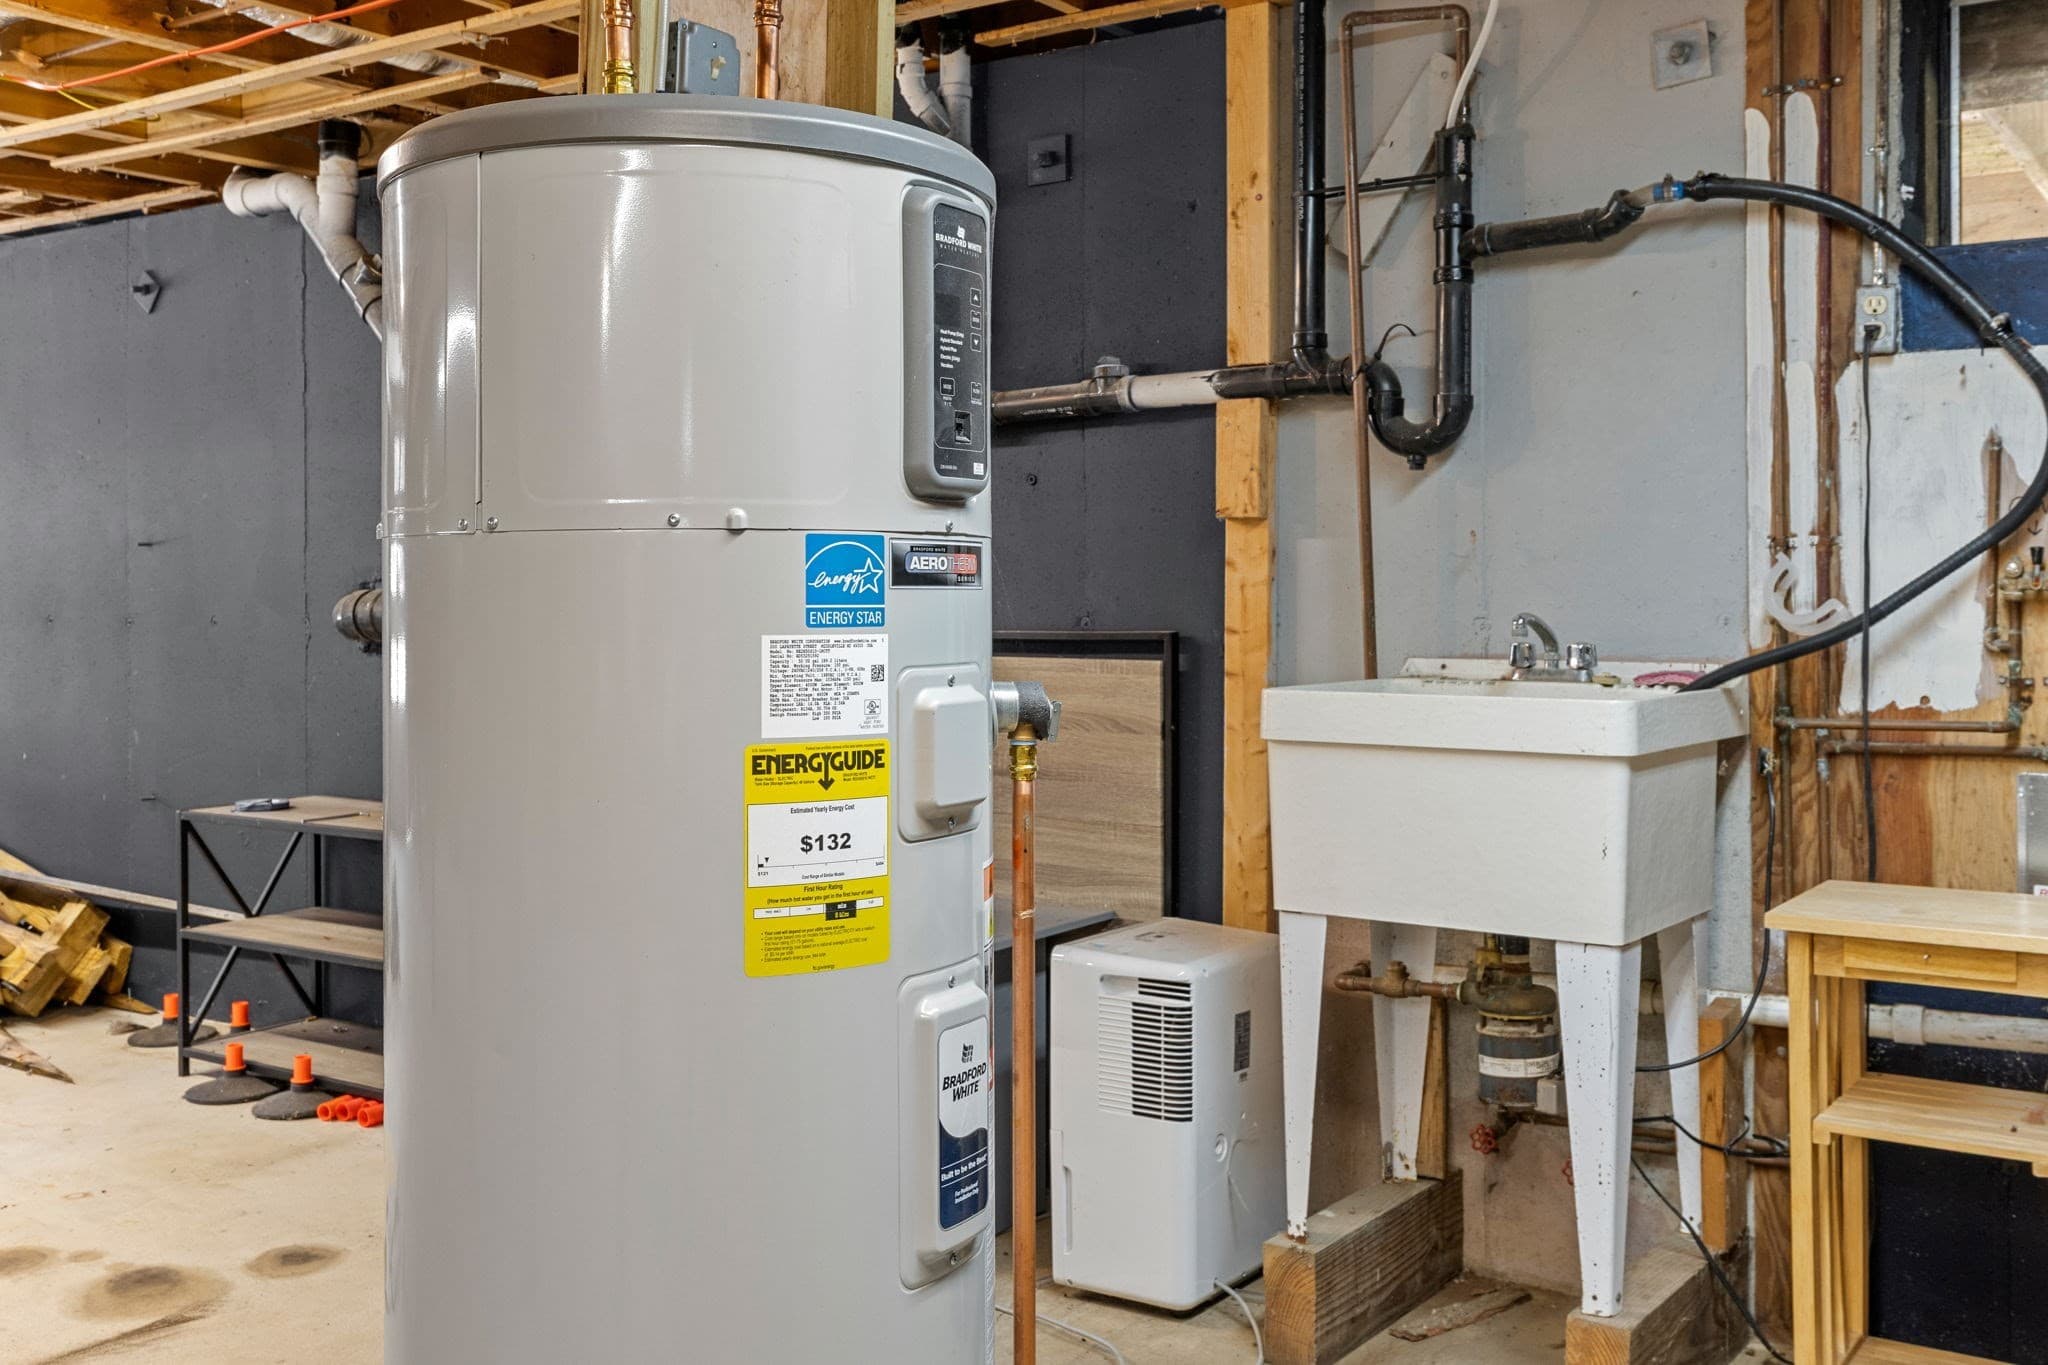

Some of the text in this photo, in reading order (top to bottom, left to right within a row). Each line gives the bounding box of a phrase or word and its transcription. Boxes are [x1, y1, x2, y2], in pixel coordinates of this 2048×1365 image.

[935, 233, 982, 254] BRADFORD WHITE
[808, 571, 864, 594] energy
[810, 611, 882, 625] ENERGY STAR
[752, 749, 885, 776] ENERGYGUIDE
[814, 805, 828, 814] Yearly
[800, 832, 851, 855] $132
[828, 883, 843, 891] Rating
[942, 1062, 987, 1102] BRADFORD WHITE
[941, 1170, 954, 1182] Built
[954, 1168, 961, 1177] to
[960, 1165, 968, 1174] be
[968, 1161, 976, 1170] the
